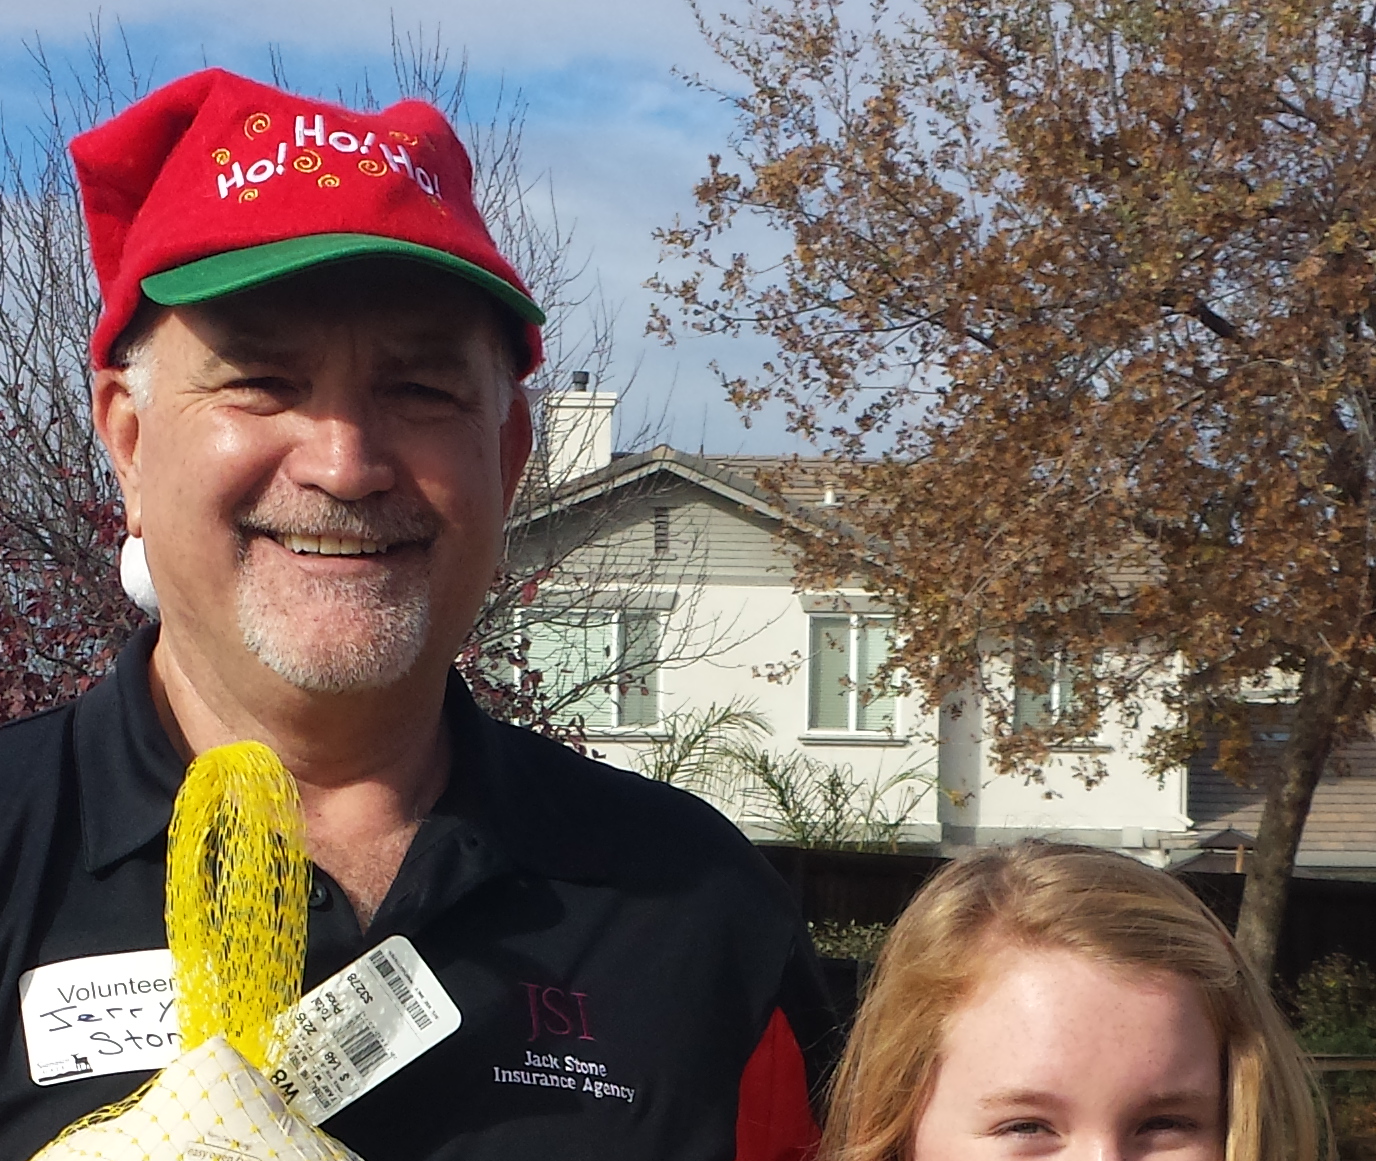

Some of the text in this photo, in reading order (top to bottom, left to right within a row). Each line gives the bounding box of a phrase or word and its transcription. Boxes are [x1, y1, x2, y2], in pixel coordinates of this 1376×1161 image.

[519, 982, 597, 1042] JSI
[524, 1050, 608, 1077] Jack Stone
[493, 1066, 635, 1103] Insurance Agency
